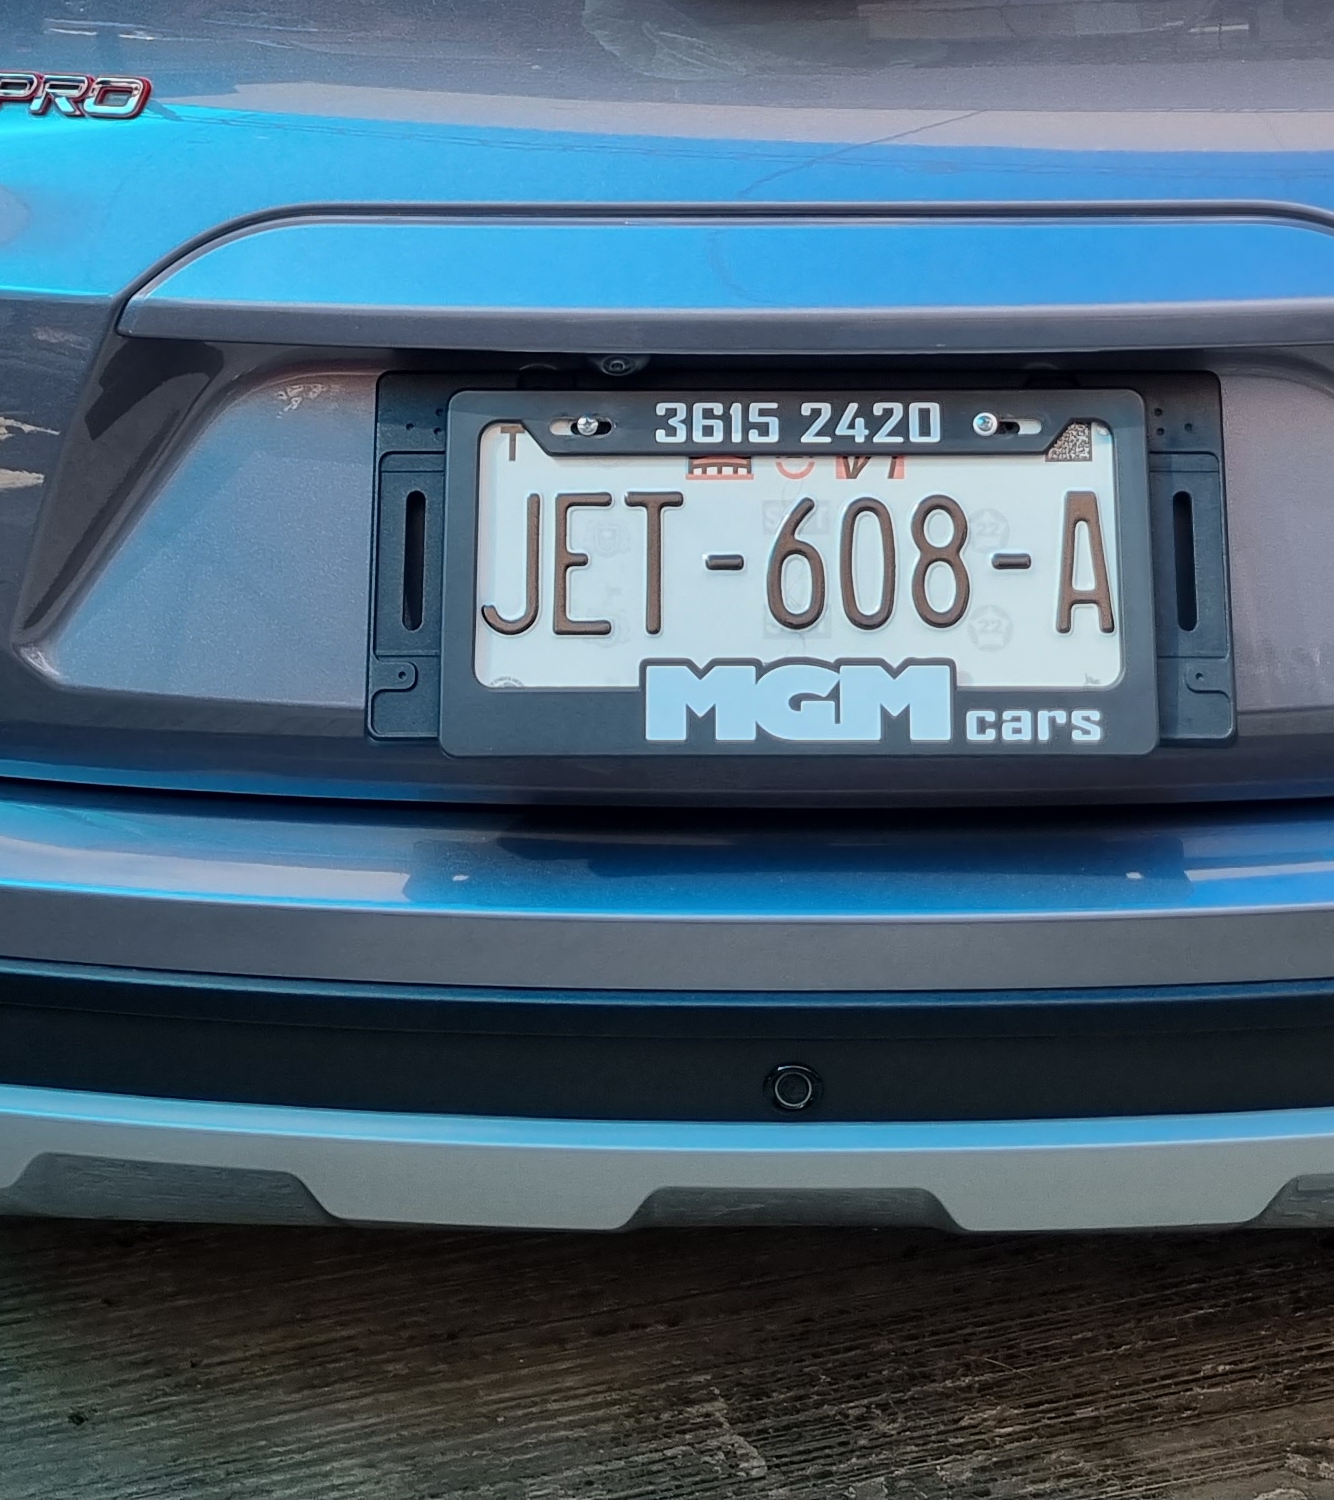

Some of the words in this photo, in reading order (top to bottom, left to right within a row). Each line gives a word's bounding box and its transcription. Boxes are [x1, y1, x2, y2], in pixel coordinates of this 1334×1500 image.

[655, 402, 779, 444] 3615
[800, 402, 942, 444] 2420
[481, 491, 1116, 637] JET-608-A
[645, 663, 951, 742] MGM
[966, 710, 1101, 741] cars
